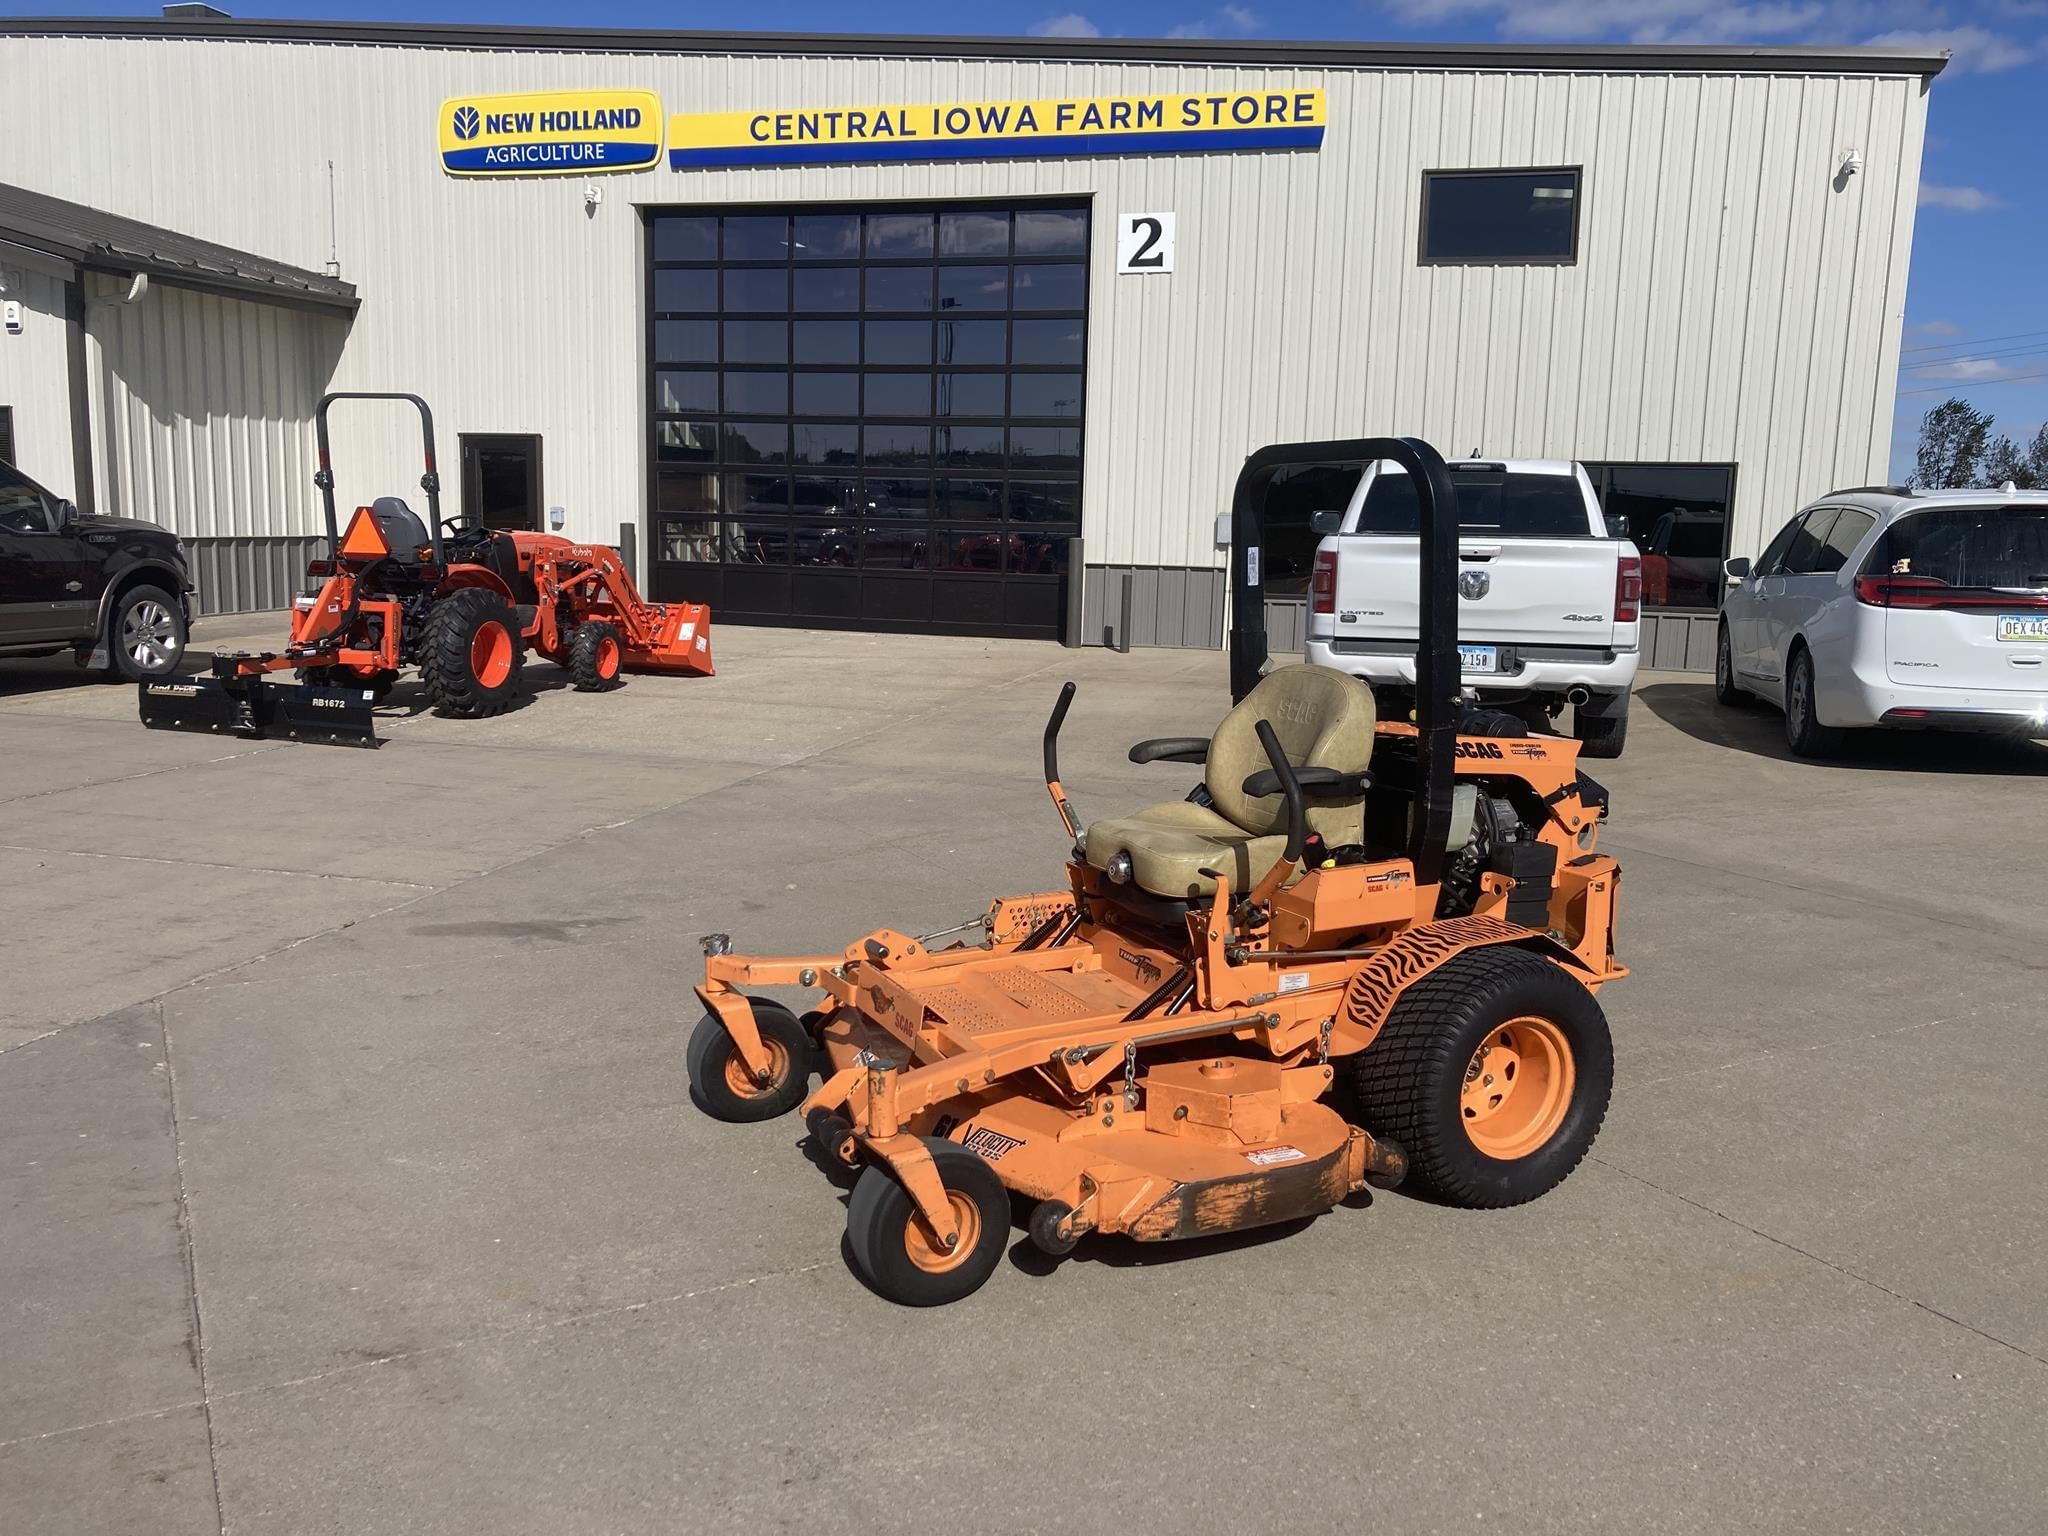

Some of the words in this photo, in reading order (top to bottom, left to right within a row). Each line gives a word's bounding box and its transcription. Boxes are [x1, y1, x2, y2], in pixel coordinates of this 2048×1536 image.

[486, 113, 533, 134] NEW
[540, 108, 641, 132] HOLLAND
[750, 110, 916, 141] CENTRAL
[933, 106, 1038, 134] IOWA
[1056, 100, 1163, 130] FARM
[1182, 94, 1315, 126] STORE
[486, 144, 604, 163] AGRICULTURE
[1128, 217, 1164, 268] 2
[1470, 654, 1487, 667] 150
[312, 698, 345, 709] RB1672
[1276, 697, 1318, 724] SCAG
[1455, 742, 1504, 759] SCAG
[895, 1012, 914, 1038] SCAG
[962, 1123, 1020, 1155] VELOCITY
